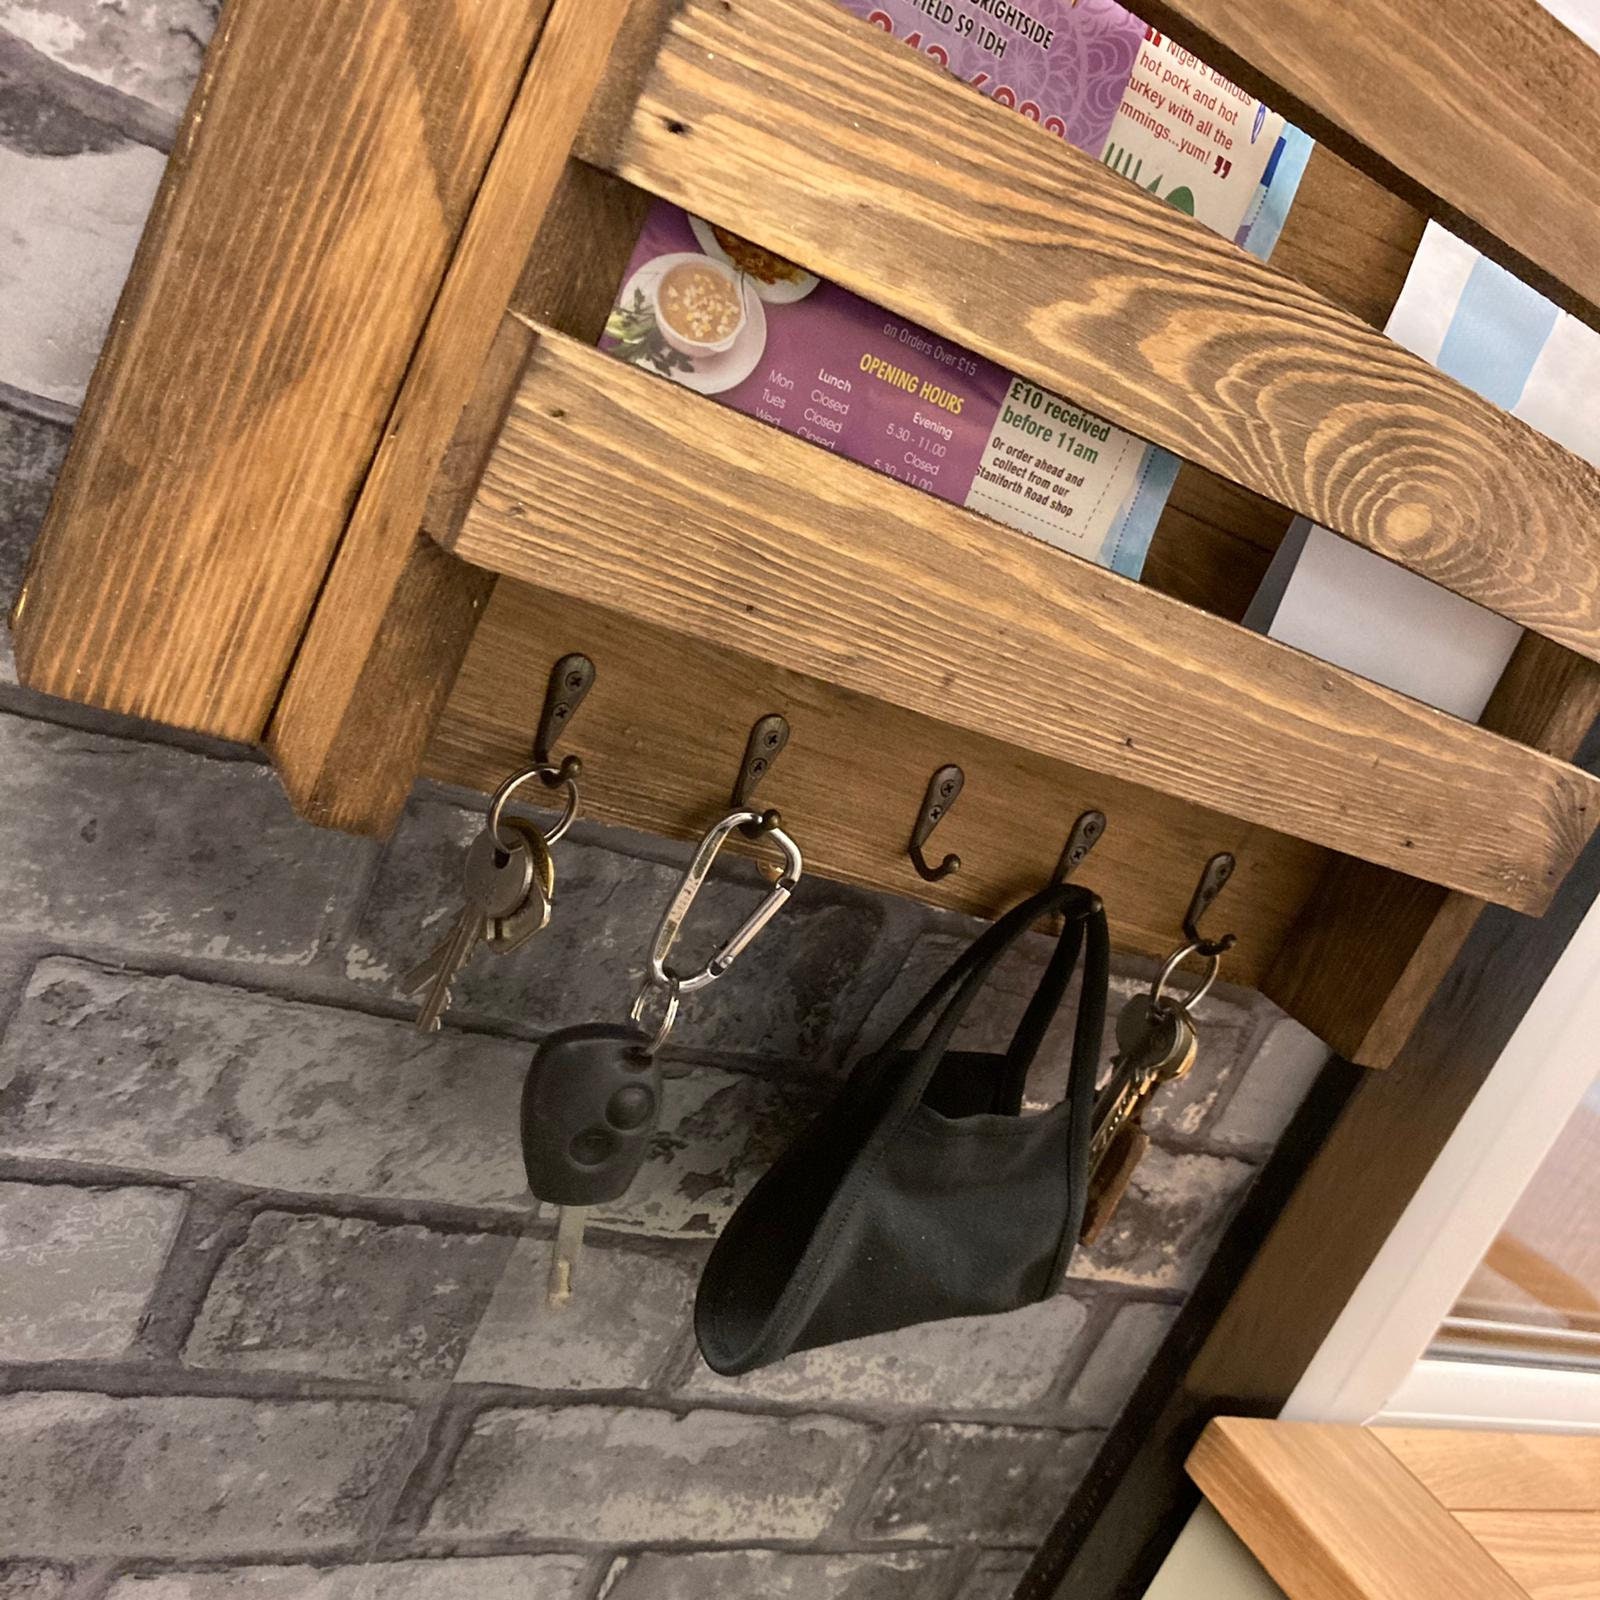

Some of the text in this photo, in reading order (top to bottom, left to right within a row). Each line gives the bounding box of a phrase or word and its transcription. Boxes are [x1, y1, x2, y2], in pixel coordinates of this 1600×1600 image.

[954, 14, 974, 37] S9
[977, 26, 1007, 58] 1DH
[970, 0, 1054, 49] RIGHTSIDE
[1166, 40, 1208, 76] Nigels
[1139, 50, 1239, 126] hot pork and hot
[1128, 76, 1233, 151] urkey with all the
[899, 328, 933, 355] Orders
[934, 345, 957, 366] Over
[957, 357, 978, 376] £15
[762, 388, 786, 409] Tues
[768, 369, 795, 391] Mon
[817, 368, 852, 392] Lunch
[859, 353, 965, 415] OPENING HOURS
[803, 407, 844, 433] Closed
[811, 388, 850, 415] Closed
[1010, 382, 1111, 443] £10 received
[885, 423, 910, 443] 5.30
[918, 436, 947, 458] 11.00
[912, 412, 953, 441] Evening
[1001, 405, 1100, 464] before 11am
[903, 451, 940, 476] Closed
[992, 436, 1085, 487] Or order ahead and
[992, 457, 1070, 497] collect from our
[1024, 487, 1051, 505] Road
[1050, 500, 1073, 517] shop
